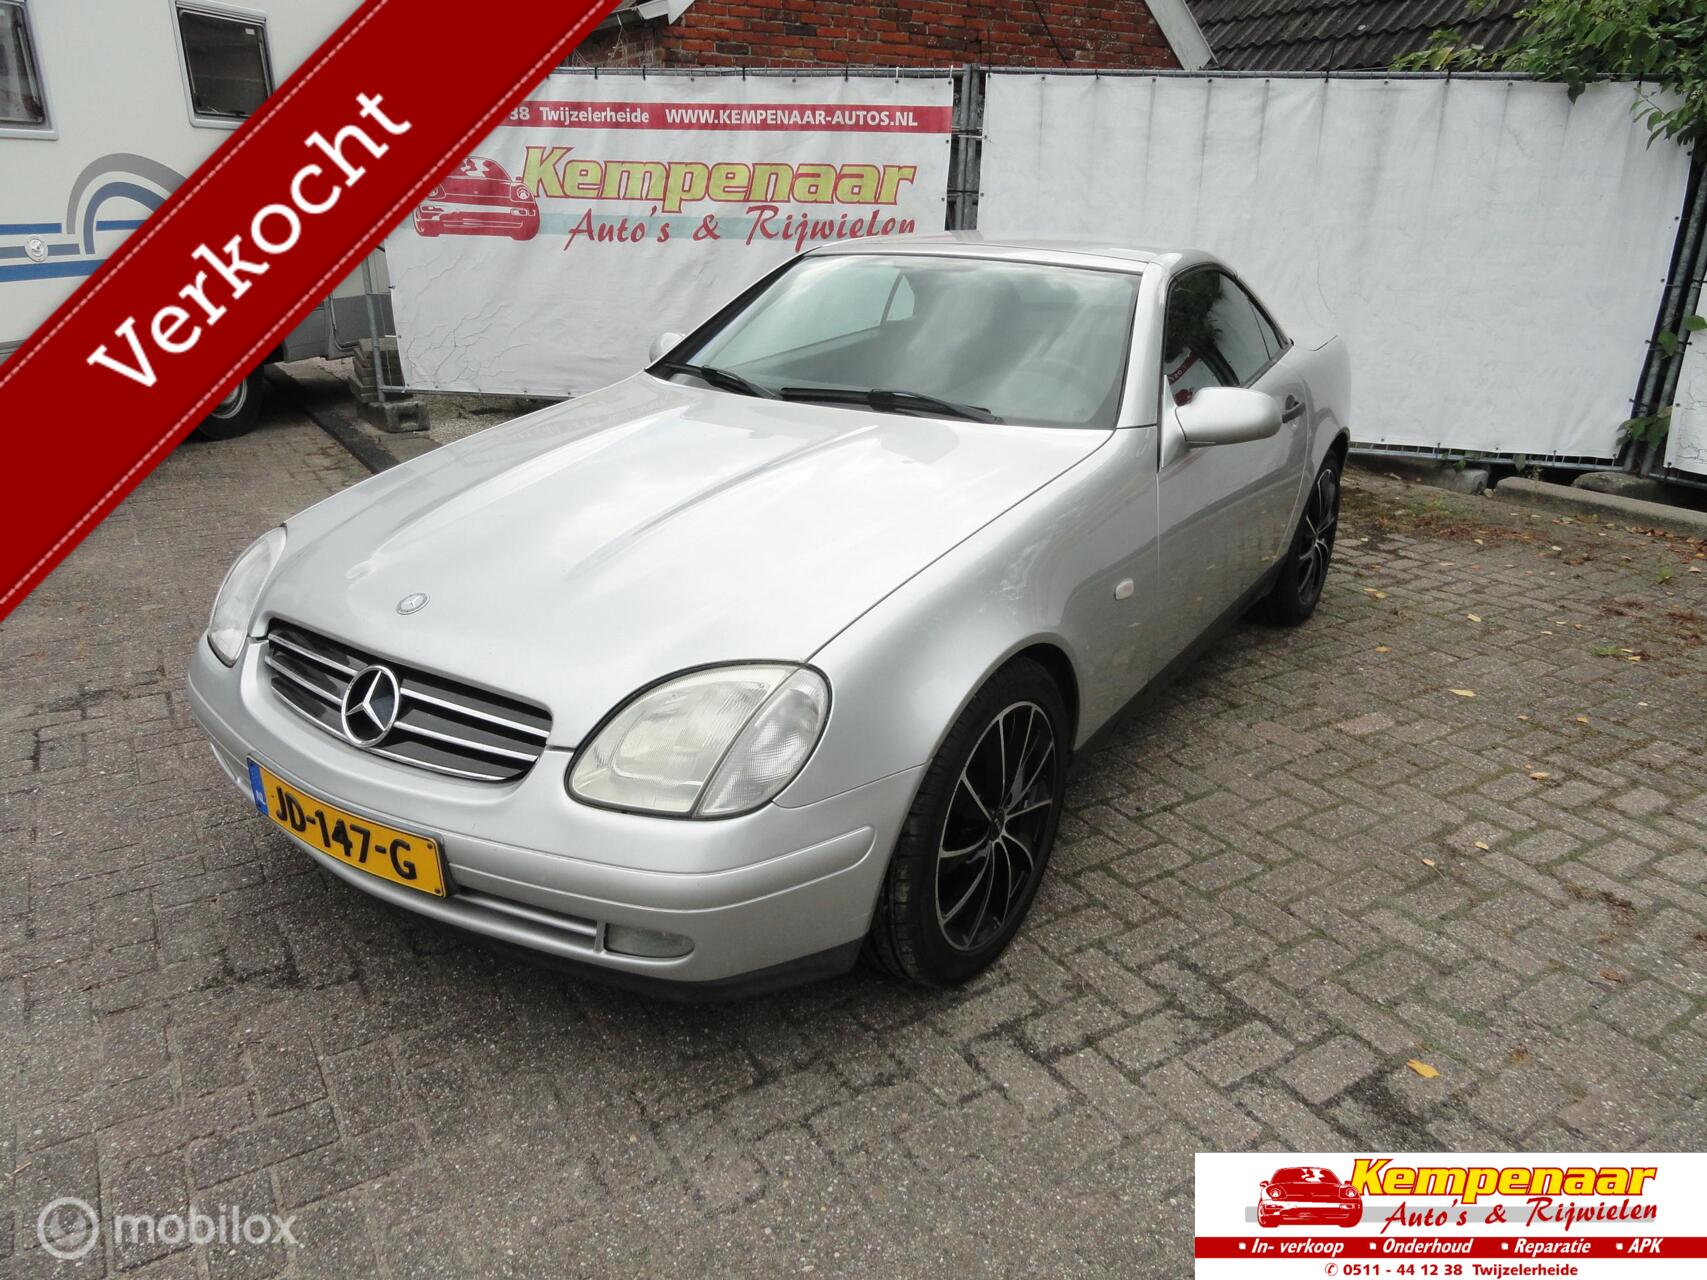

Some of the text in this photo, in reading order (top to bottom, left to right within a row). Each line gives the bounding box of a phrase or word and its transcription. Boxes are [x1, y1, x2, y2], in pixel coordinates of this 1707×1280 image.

[539, 106, 650, 125] Twijzelerheide
[665, 109, 918, 127] WWW.KEMPENAAR-AUTOS.NL
[523, 146, 918, 214] Kempenaar
[564, 204, 915, 253] Auto's & Rijwielen
[276, 786, 417, 880] JD-147-G
